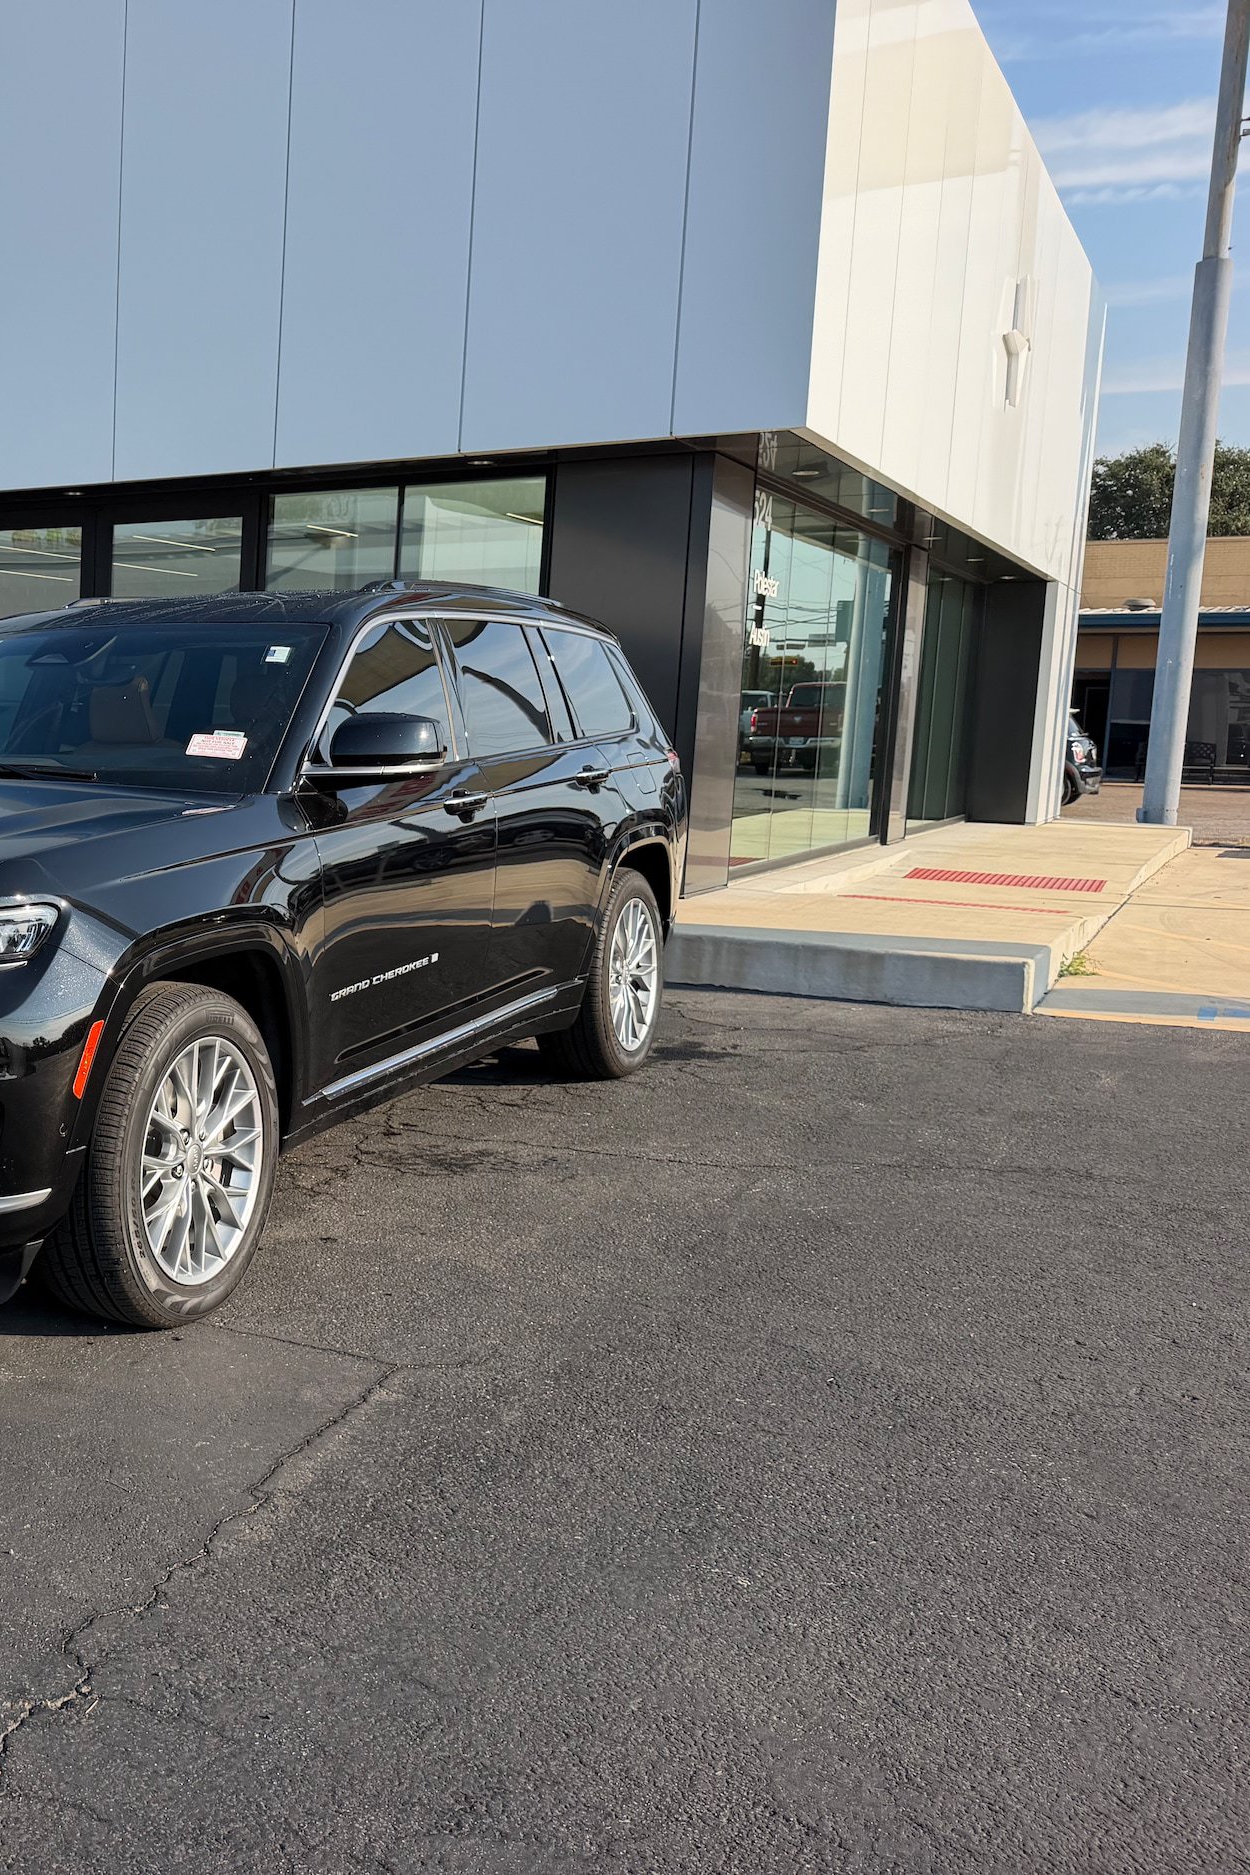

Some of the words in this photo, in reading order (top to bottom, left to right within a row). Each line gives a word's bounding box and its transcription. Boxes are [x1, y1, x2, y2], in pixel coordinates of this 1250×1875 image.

[753, 568, 779, 597] Polestar
[749, 621, 771, 647] Austin
[330, 979, 371, 1002] GRAND
[371, 956, 430, 985] CHEROKEE
